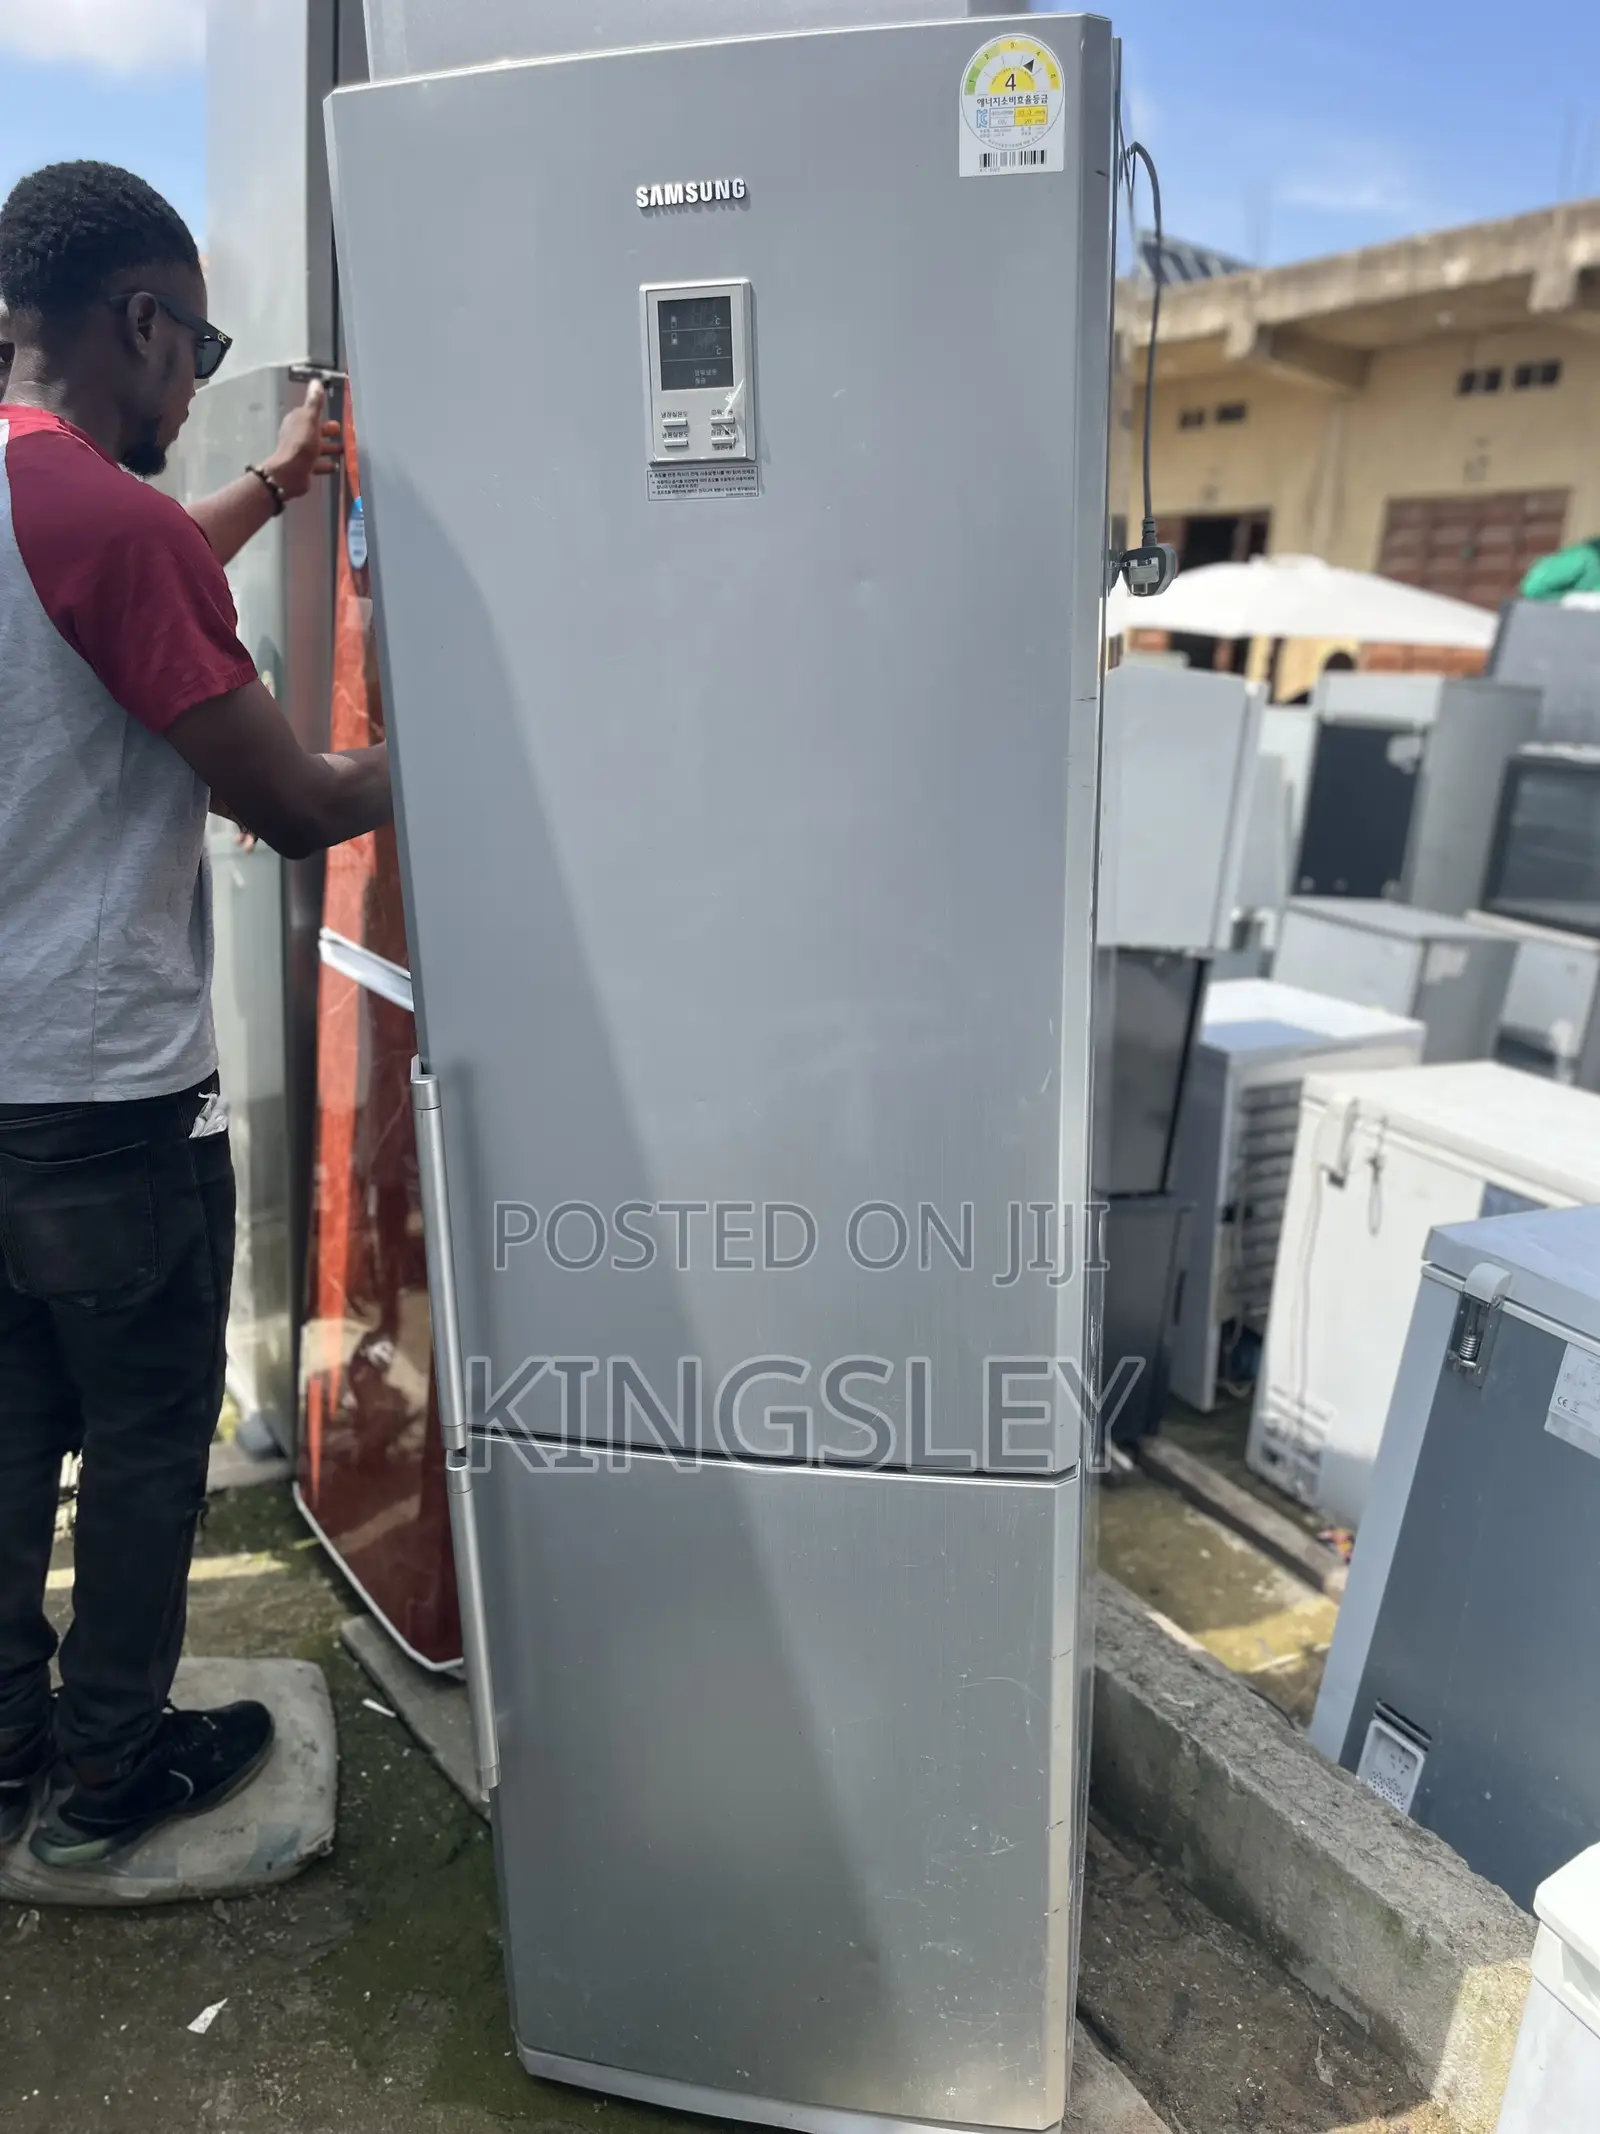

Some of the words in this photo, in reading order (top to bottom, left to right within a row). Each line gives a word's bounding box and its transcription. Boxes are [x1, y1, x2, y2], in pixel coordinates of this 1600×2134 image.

[1004, 73, 1017, 91] 4
[976, 94, 1048, 107] 에너지소비효율등급
[636, 177, 746, 208] SAMSUNG
